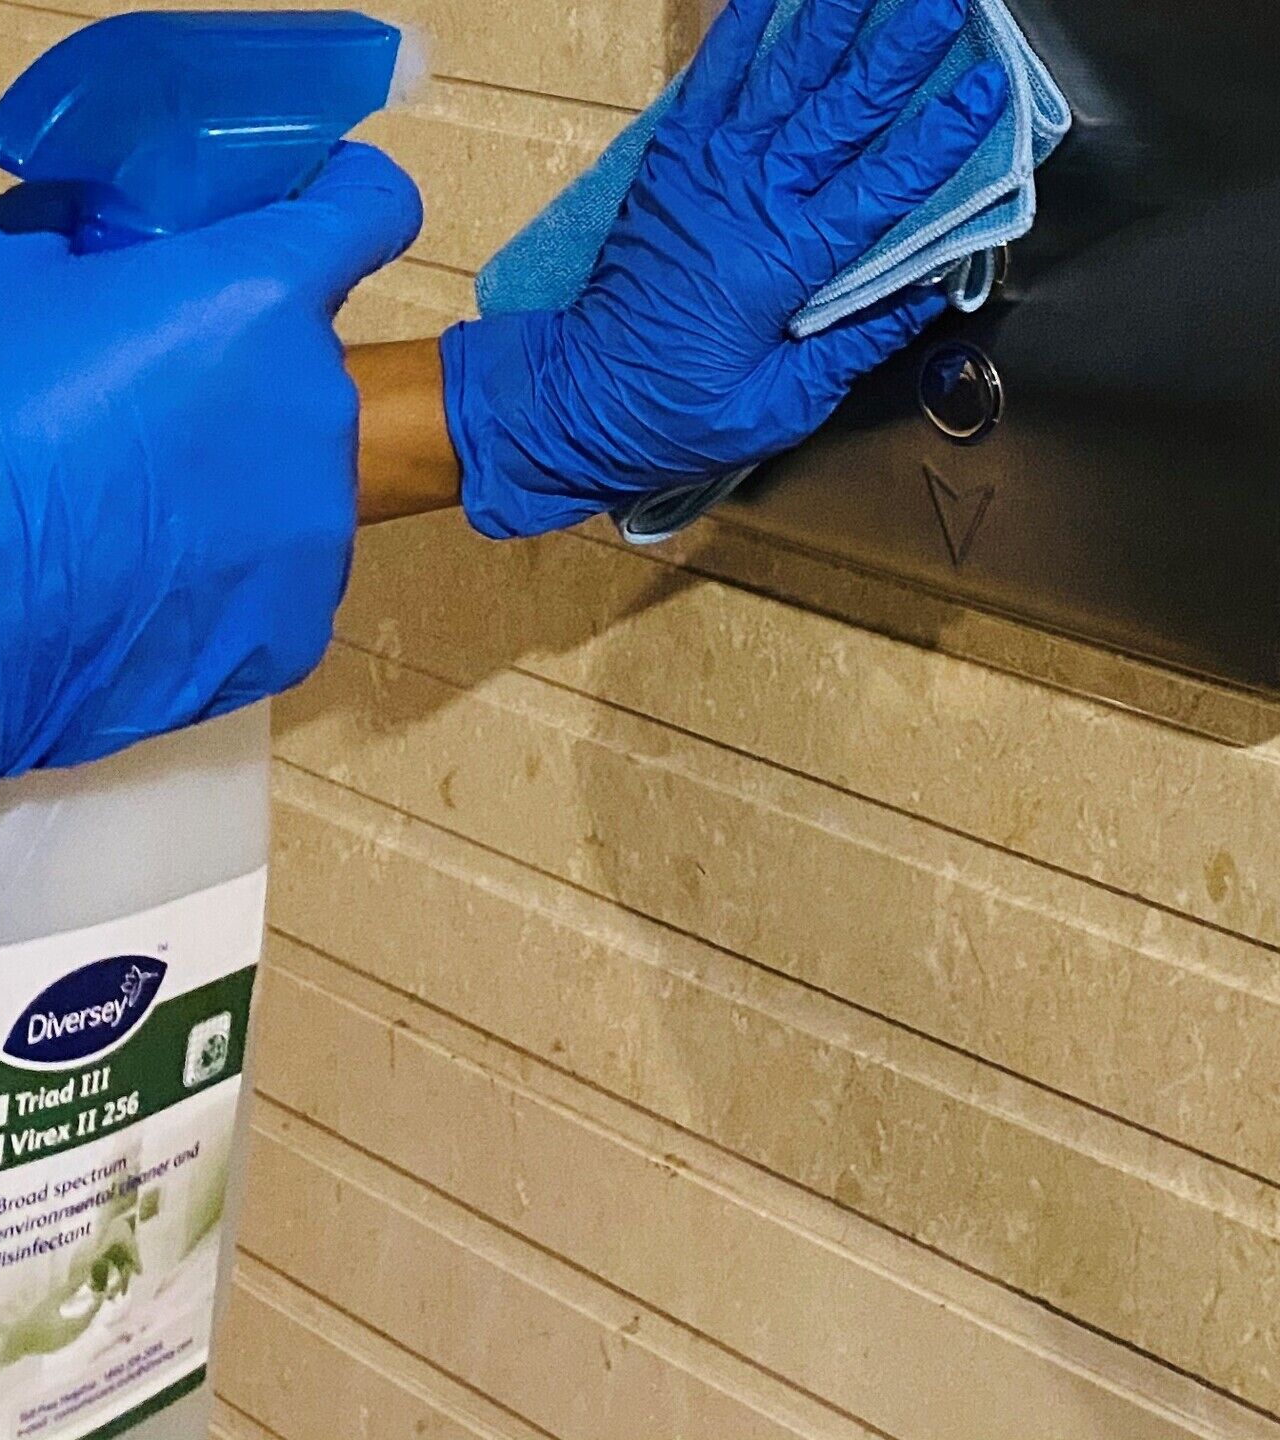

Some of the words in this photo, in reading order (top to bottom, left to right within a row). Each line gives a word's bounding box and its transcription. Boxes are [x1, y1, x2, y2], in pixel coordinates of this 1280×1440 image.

[27, 995, 128, 1046] Diversey
[15, 1077, 74, 1117] Triad
[78, 1067, 111, 1098] III
[10, 1123, 71, 1157] Virex
[75, 1109, 97, 1137] II
[100, 1090, 141, 1127] 256
[53, 1157, 128, 1200] spectrum
[172, 1140, 200, 1169] and
